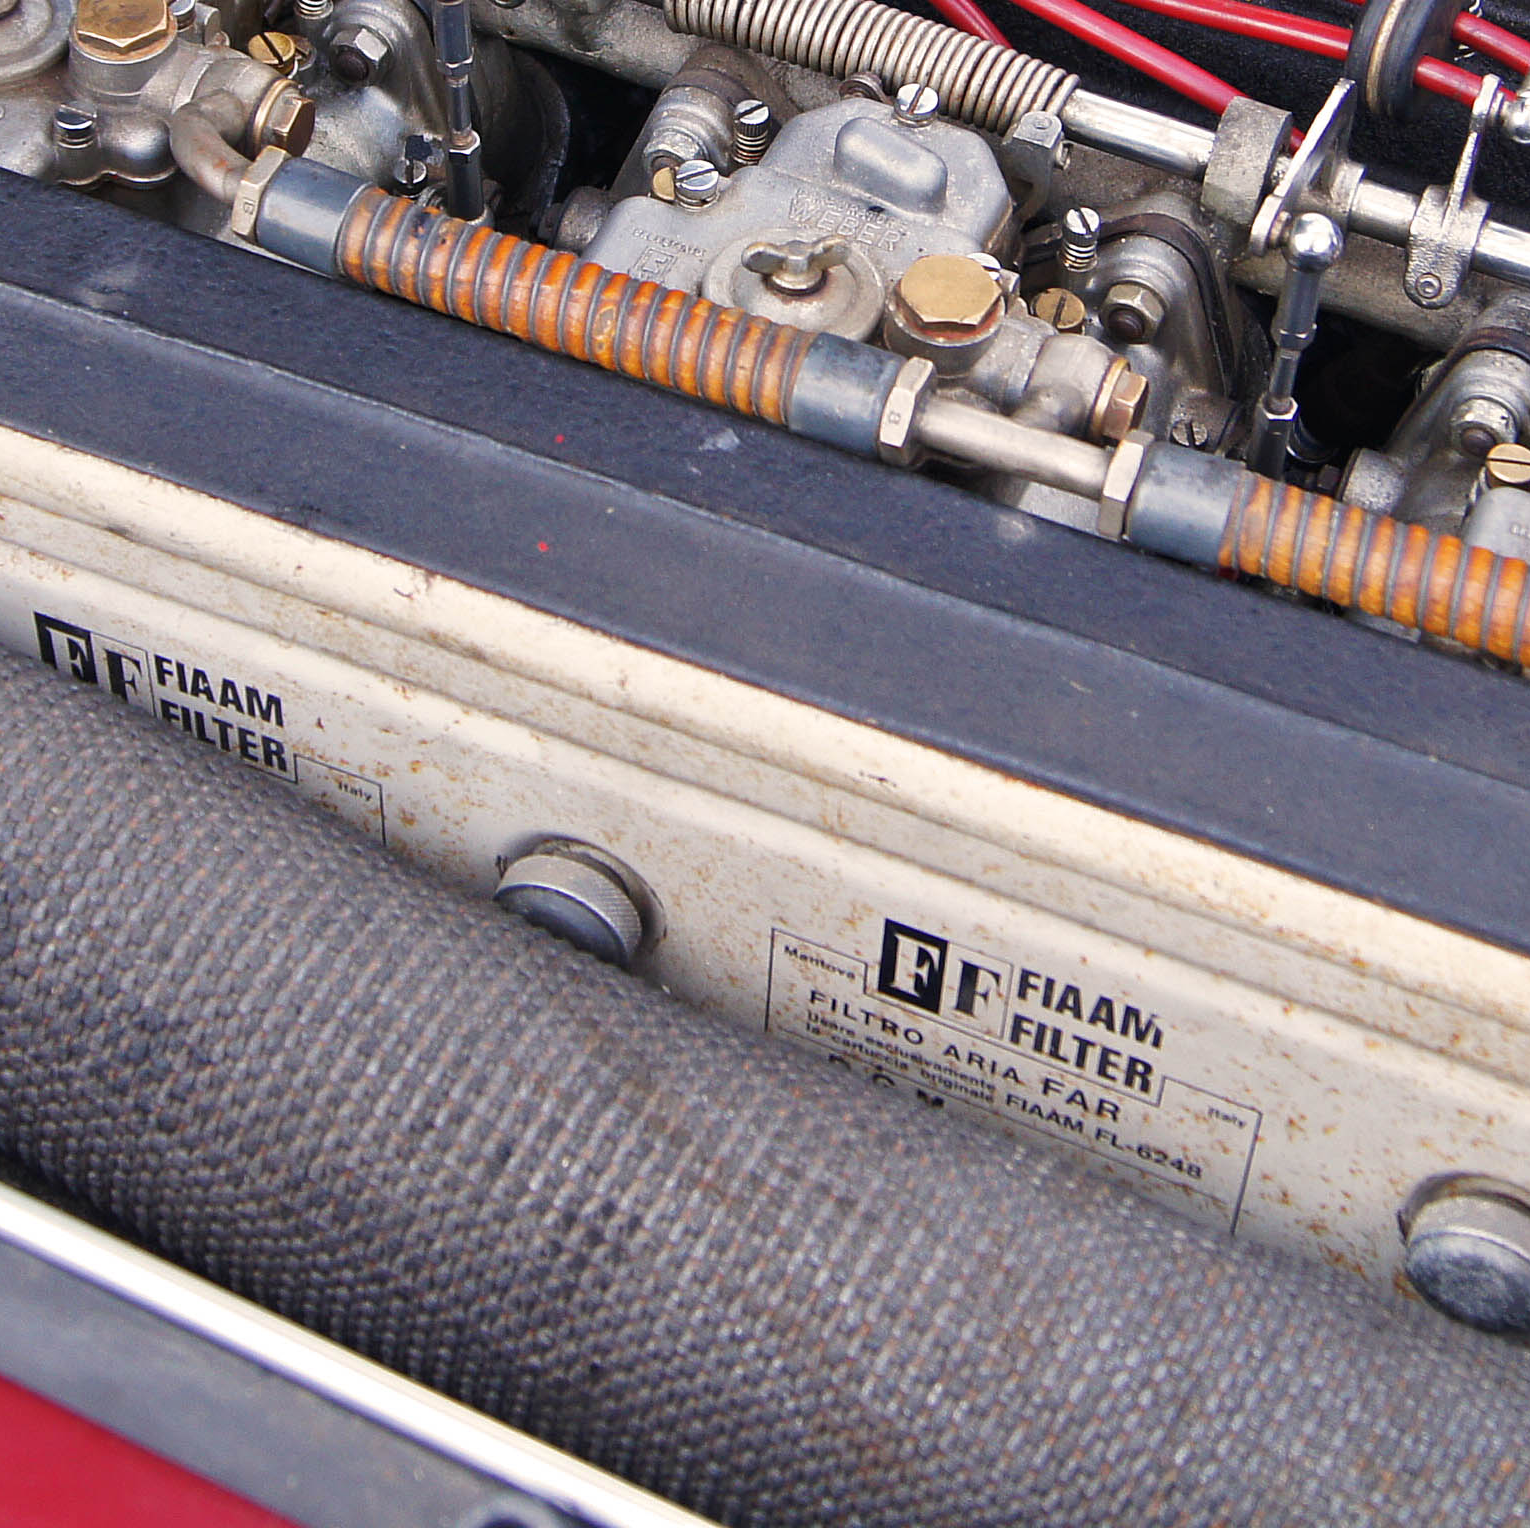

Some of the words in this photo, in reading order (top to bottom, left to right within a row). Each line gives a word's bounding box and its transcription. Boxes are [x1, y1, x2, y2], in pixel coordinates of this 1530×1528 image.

[788, 198, 902, 252] WEBER
[154, 653, 284, 728] FIAAM
[160, 699, 287, 771] FILTER
[1016, 967, 1164, 1049] FIAAM
[807, 1010, 856, 1038] Usare
[865, 1035, 996, 1092] esclusivamente
[810, 989, 923, 1045] FILTRO
[943, 1043, 1022, 1084] ARIA
[1042, 1076, 1120, 1122] FAR
[1009, 1012, 1155, 1094] FILTER
[1005, 1093, 1085, 1134] FIAAM
